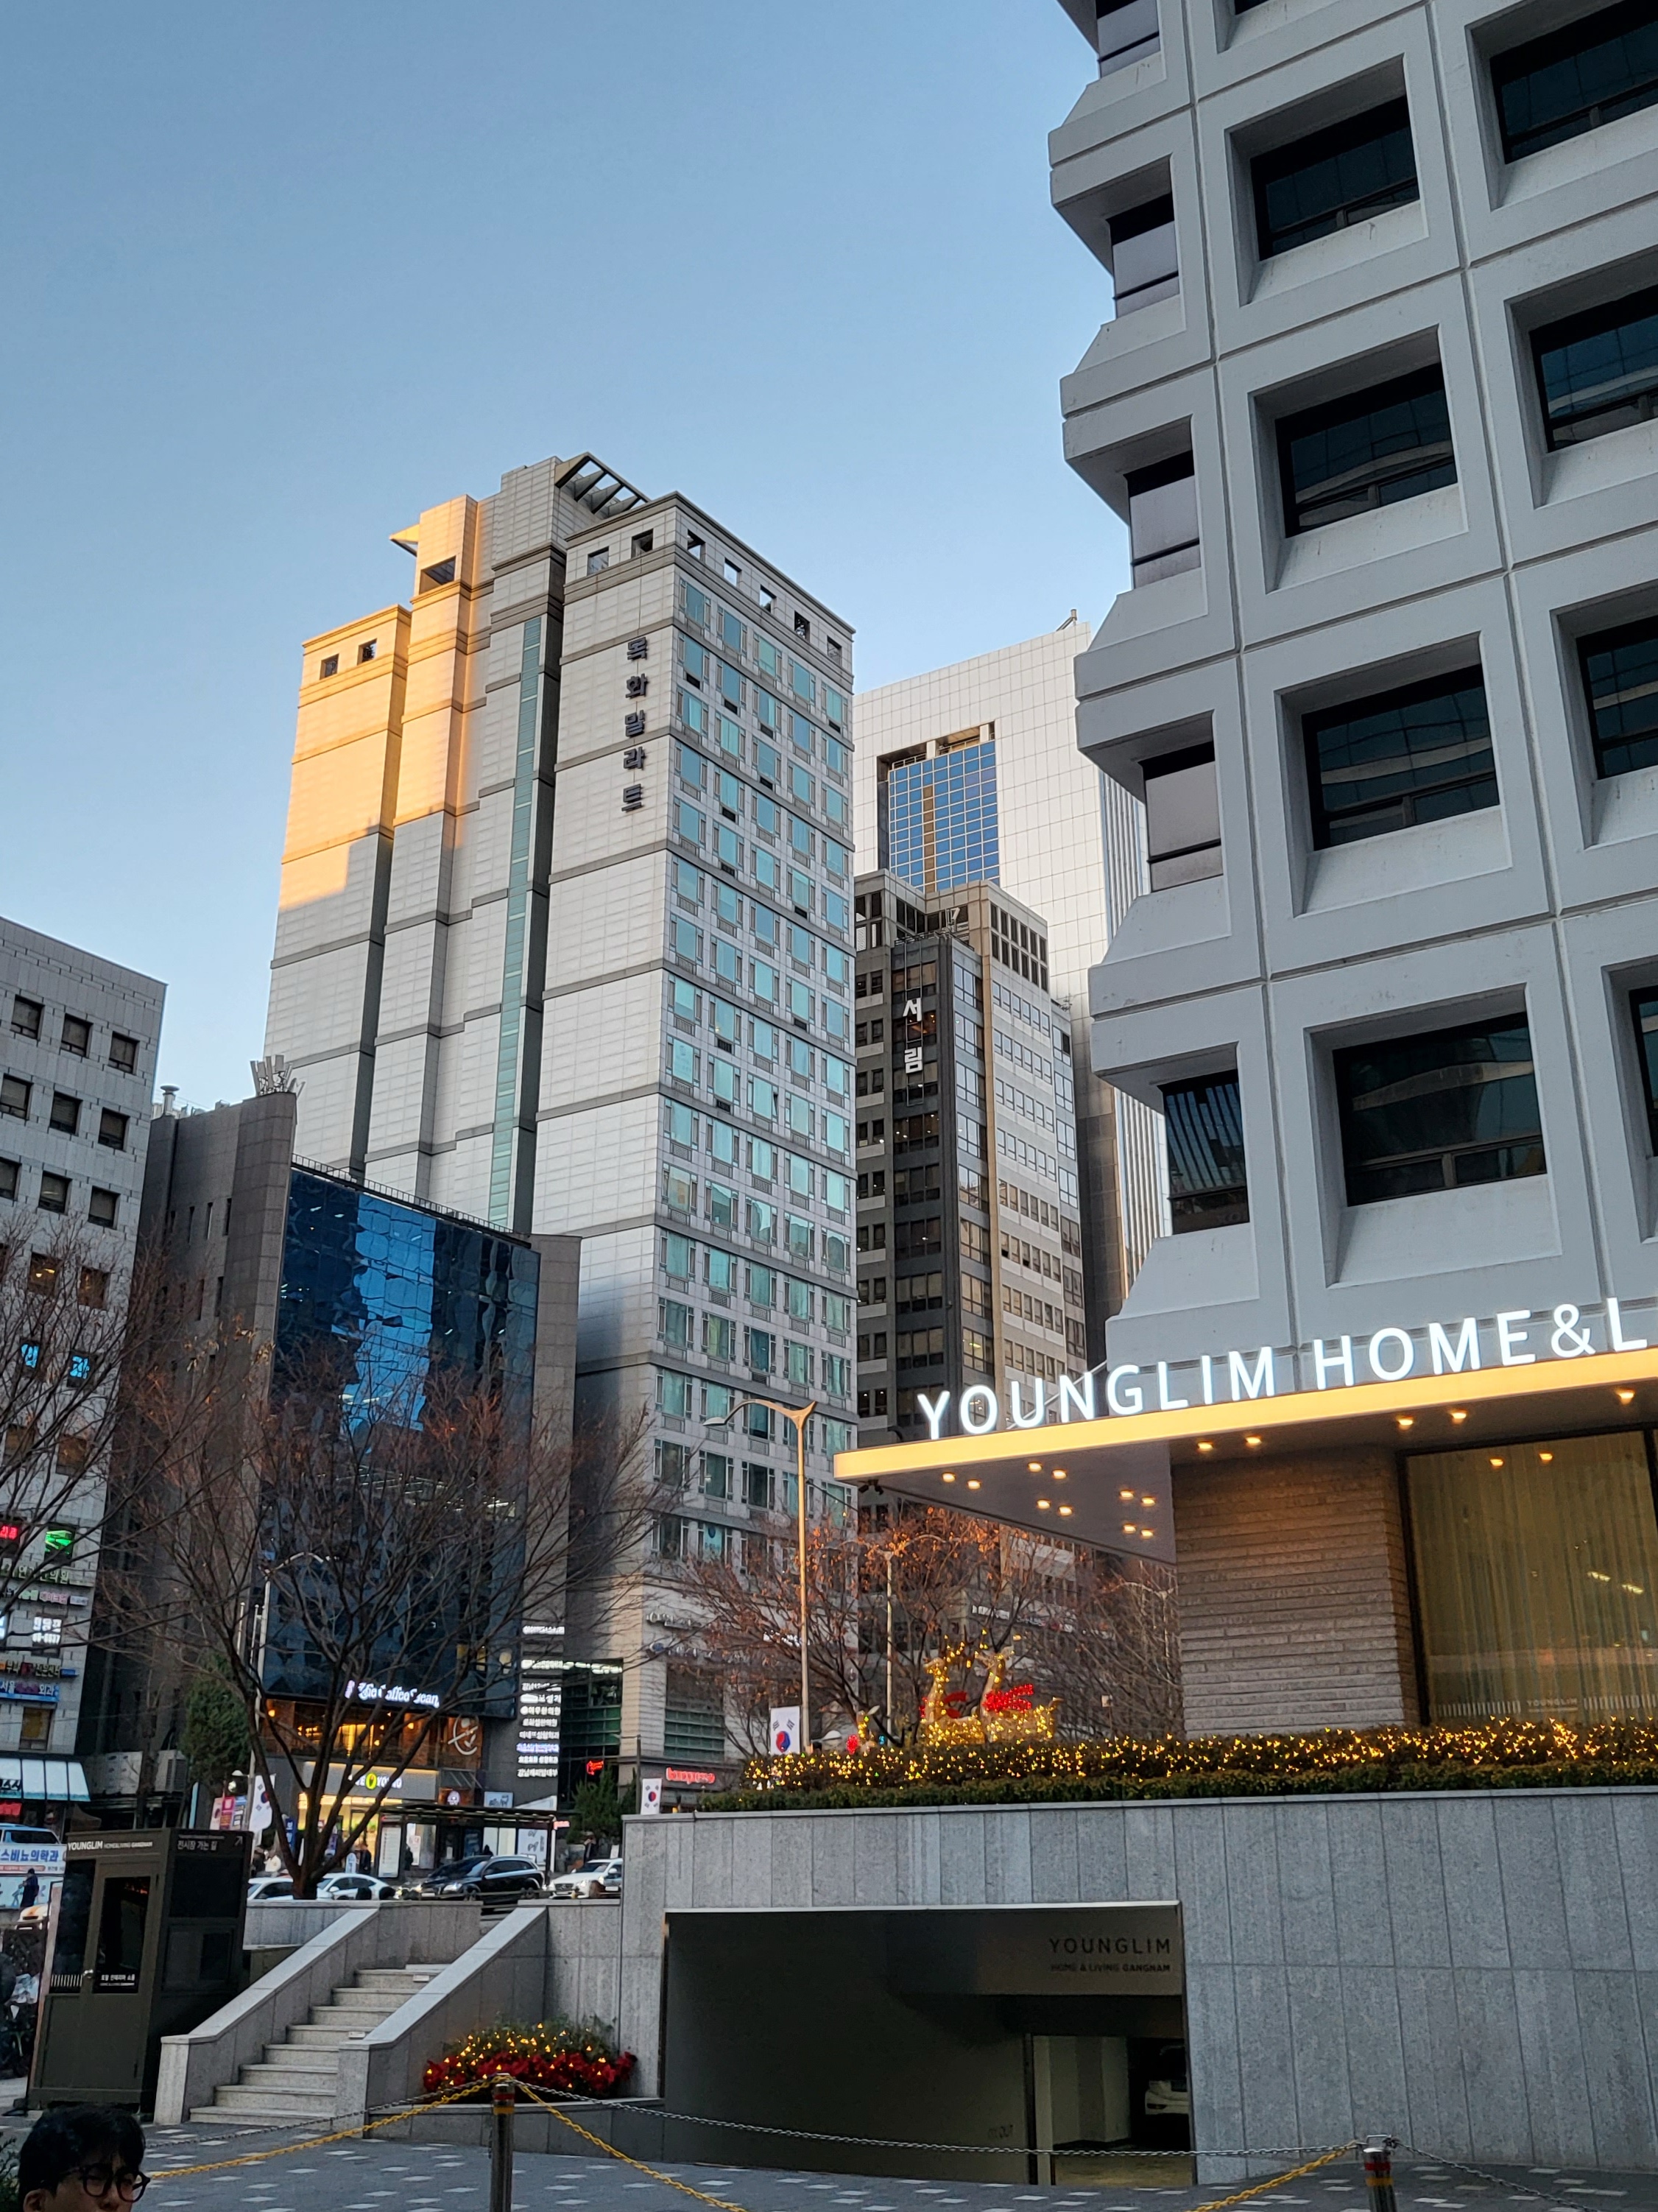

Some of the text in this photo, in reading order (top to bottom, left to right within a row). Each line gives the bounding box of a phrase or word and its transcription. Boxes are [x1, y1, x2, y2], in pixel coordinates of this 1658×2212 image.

[903, 998, 923, 1074] 서림
[917, 1346, 1275, 1440] YOUNGLIM
[68, 1841, 103, 1850] YOUNGLIM
[197, 1841, 209, 1850] 가는
[1049, 1937, 1170, 1954] YOUNGLIM
[1123, 1964, 1171, 1972] GANGNAM
